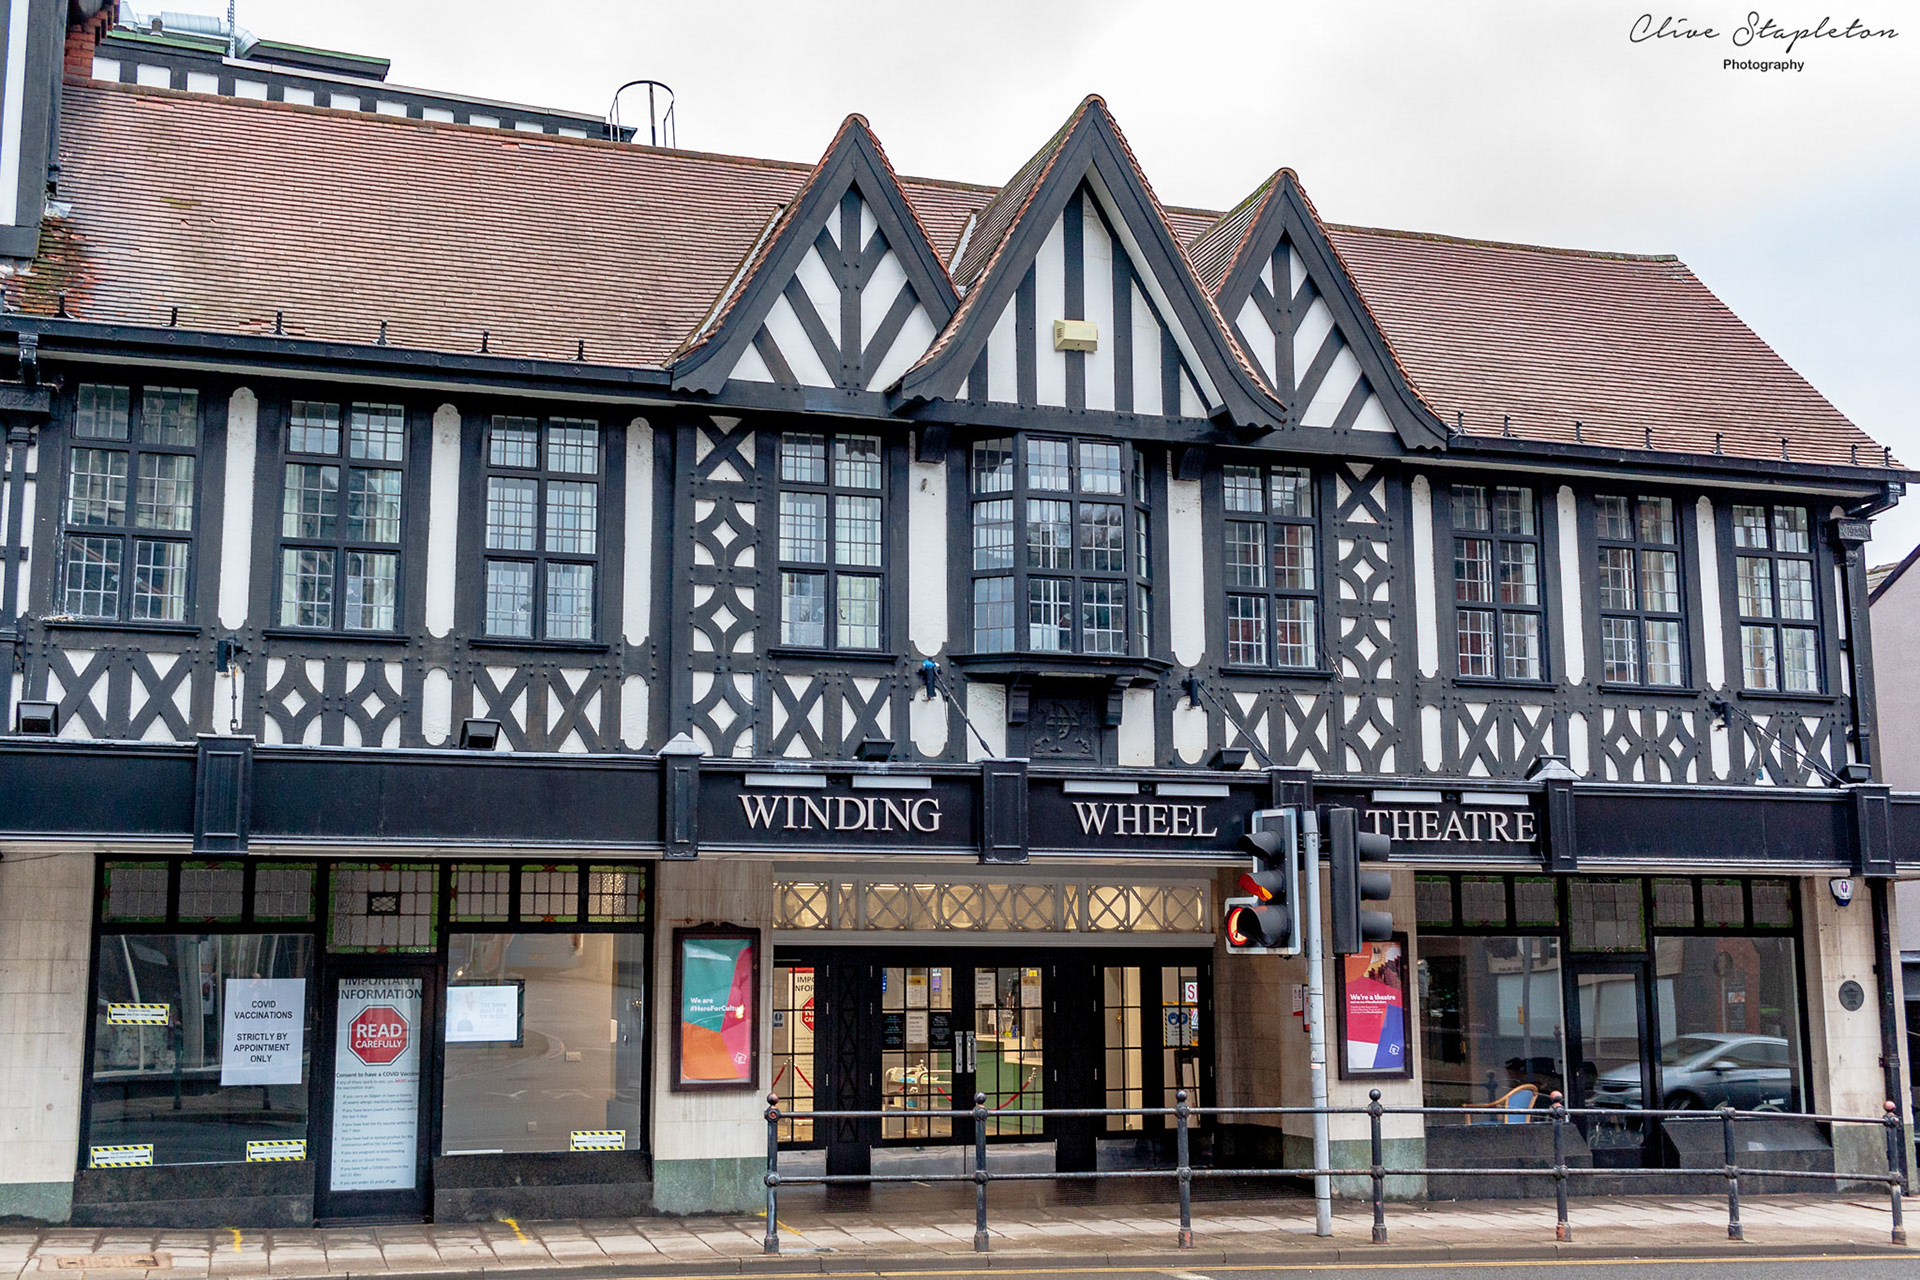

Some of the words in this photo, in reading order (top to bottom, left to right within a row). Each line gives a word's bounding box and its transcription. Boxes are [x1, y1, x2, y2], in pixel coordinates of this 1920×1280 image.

[738, 794, 942, 832] WINDING
[1072, 802, 1218, 837] WHEEL
[1366, 810, 1537, 842] THEATRE
[340, 989, 422, 999] NFORMATION
[356, 1024, 402, 1038] READ
[355, 1040, 402, 1048] CAREFULLY
